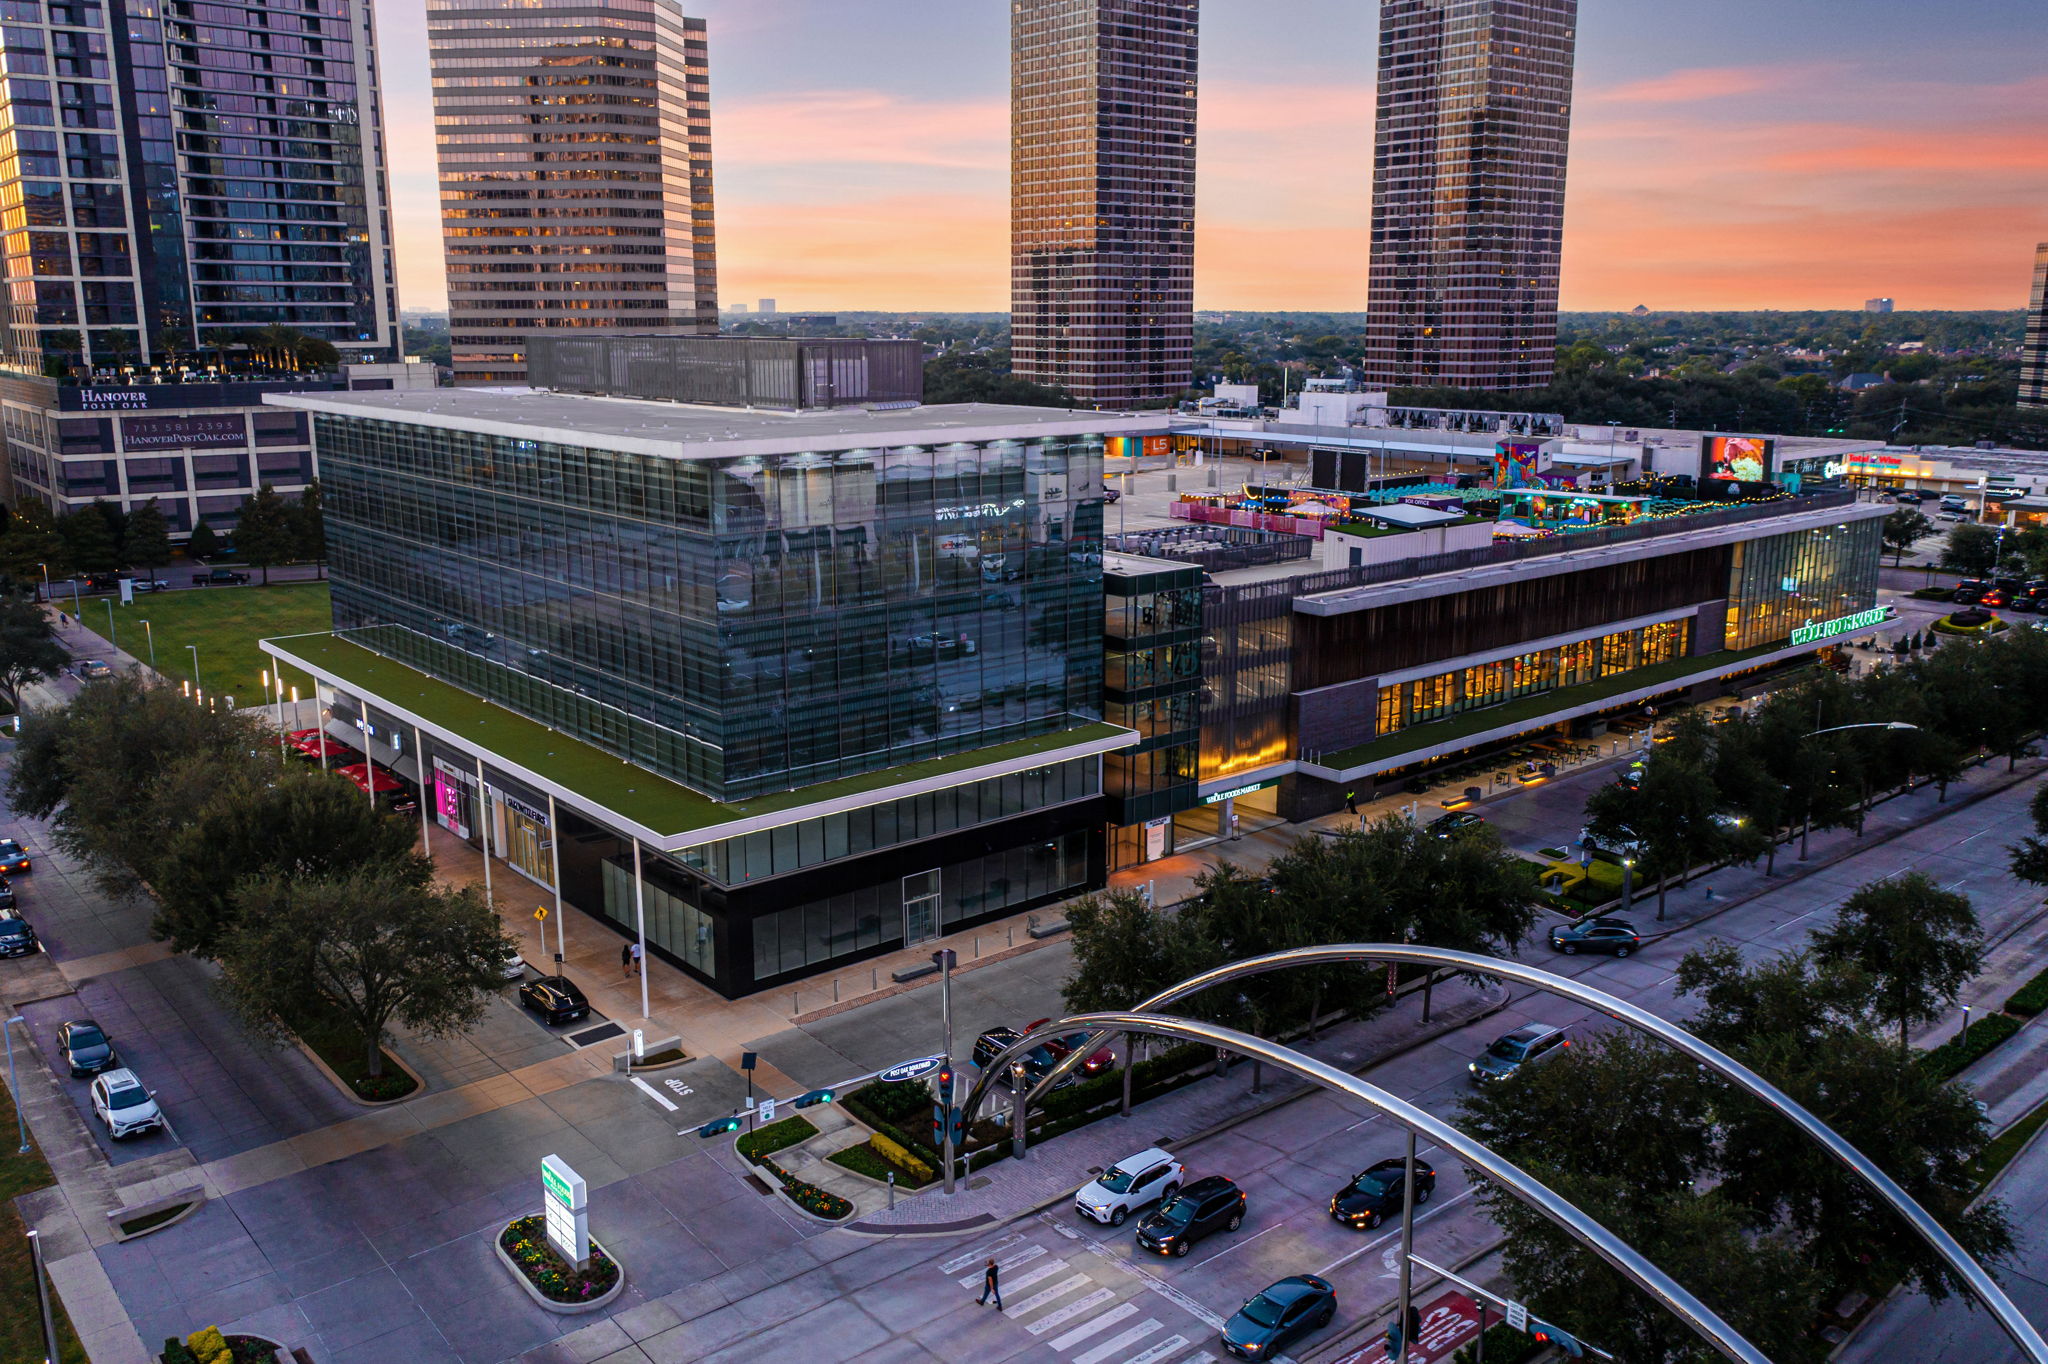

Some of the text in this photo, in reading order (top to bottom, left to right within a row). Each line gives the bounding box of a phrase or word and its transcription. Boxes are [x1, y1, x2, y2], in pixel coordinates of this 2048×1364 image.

[80, 390, 148, 402] HANOVER
[82, 402, 116, 410] POST
[134, 422, 233, 433] 713 581 2393
[1153, 438, 1168, 450] L5
[1206, 783, 1261, 804] WHOLE FOODS MARKET
[890, 1068, 900, 1077] POST
[664, 1079, 694, 1096] STOP
